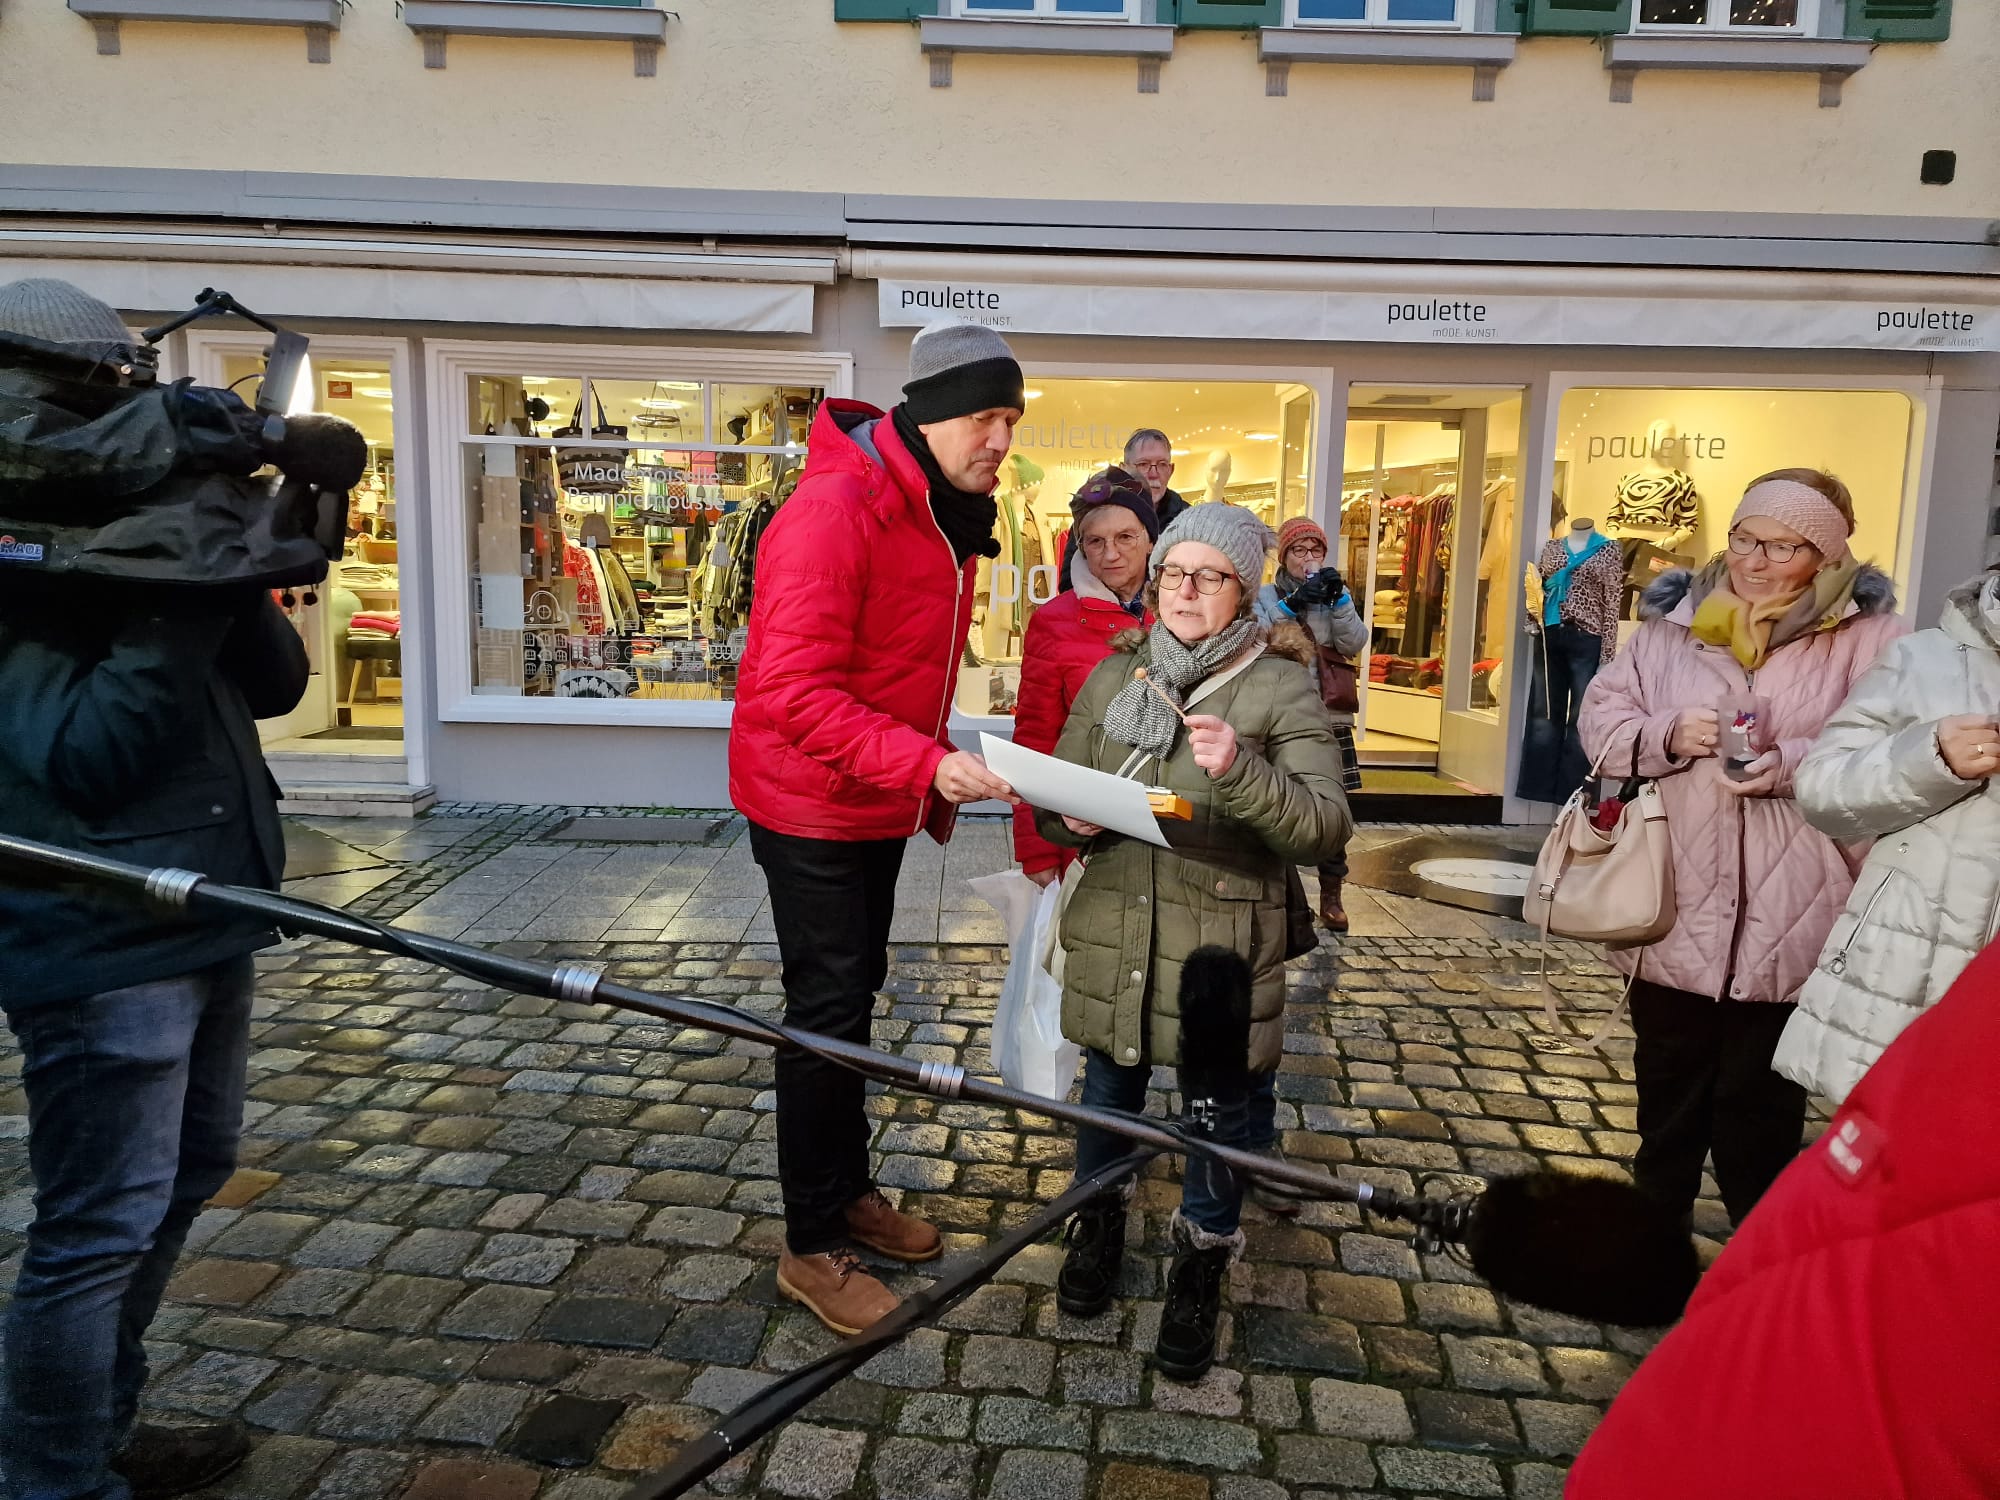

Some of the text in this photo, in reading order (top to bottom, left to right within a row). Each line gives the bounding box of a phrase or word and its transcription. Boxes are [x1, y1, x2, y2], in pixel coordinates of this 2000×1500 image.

[901, 286, 1000, 310] paulette
[1388, 299, 1486, 324] paulette
[1877, 307, 1974, 332] paulette
[1011, 418, 1133, 450] aulette
[1588, 429, 1726, 464] paulette
[574, 462, 721, 485] Mademoiselle
[568, 487, 726, 511] Pamplemousse
